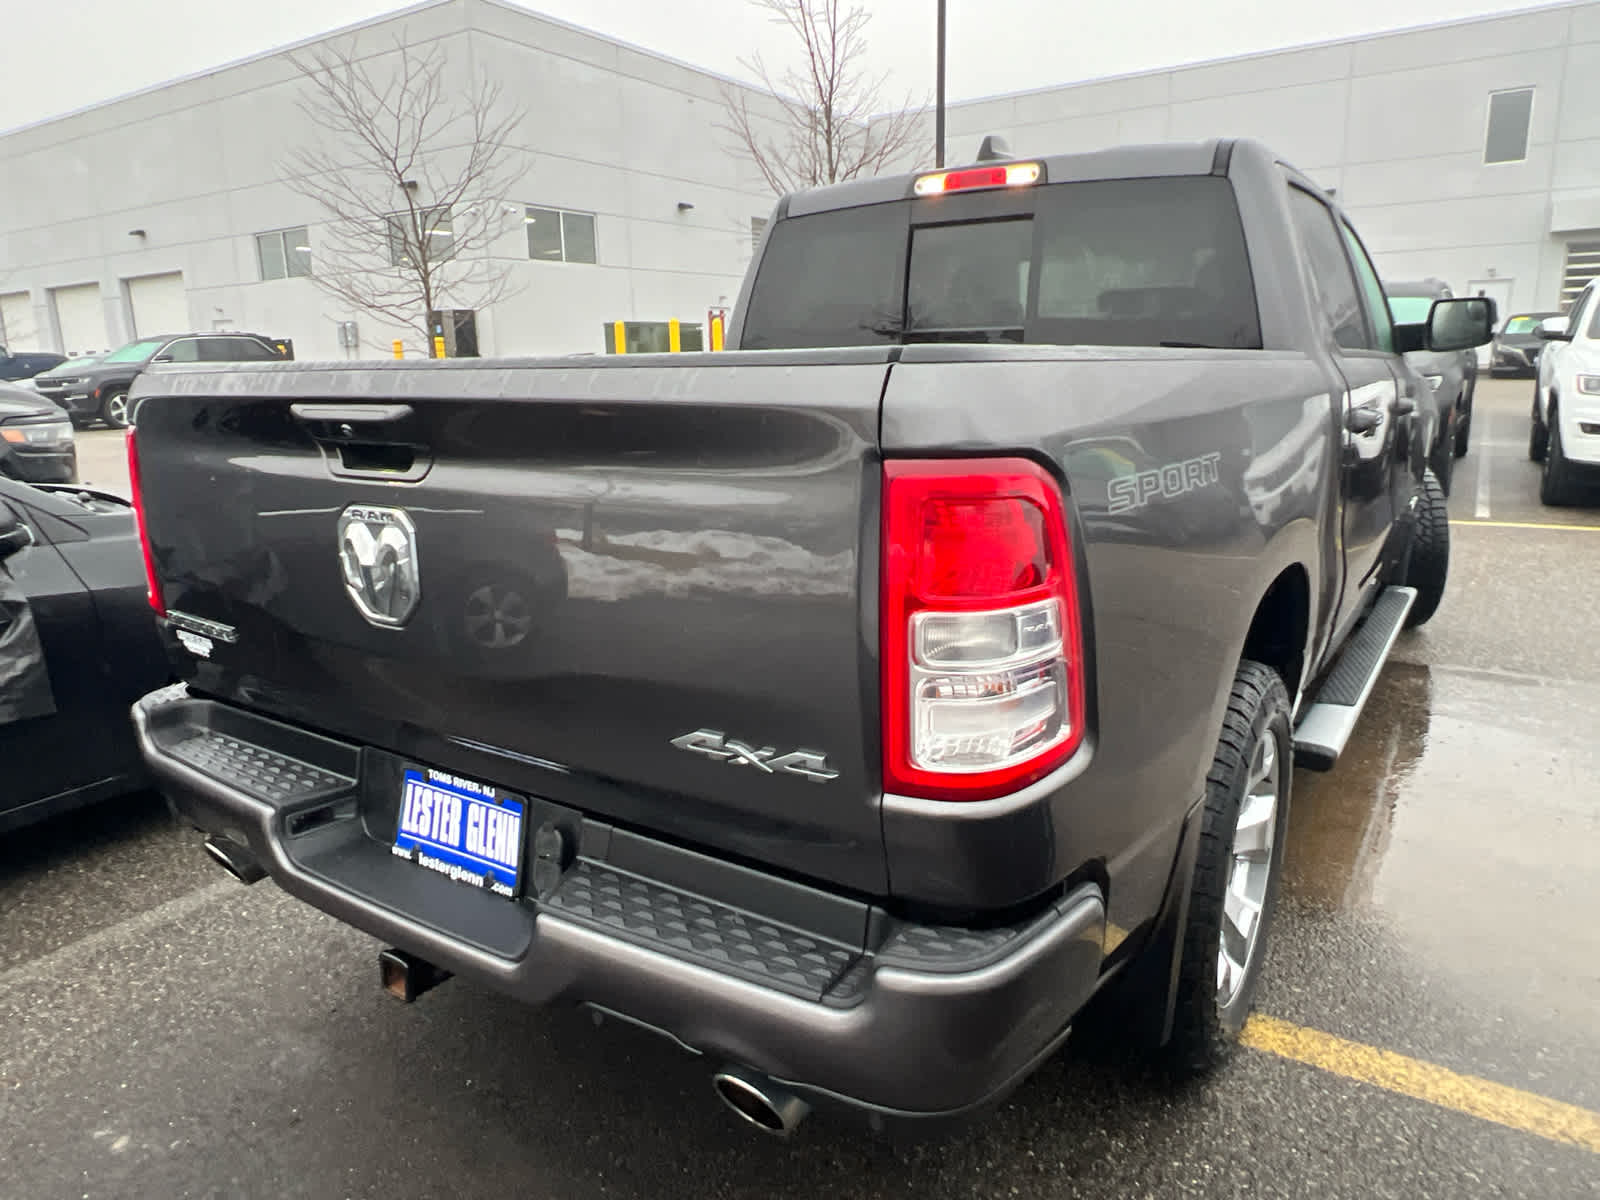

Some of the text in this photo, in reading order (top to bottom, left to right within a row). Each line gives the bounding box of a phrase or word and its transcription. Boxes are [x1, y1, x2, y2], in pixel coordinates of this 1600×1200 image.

[1107, 451, 1221, 516] SPORT
[351, 509, 395, 523] RAM
[428, 768, 496, 798] TOMS RIVER, NJ
[401, 783, 520, 868] LESTER GLENN
